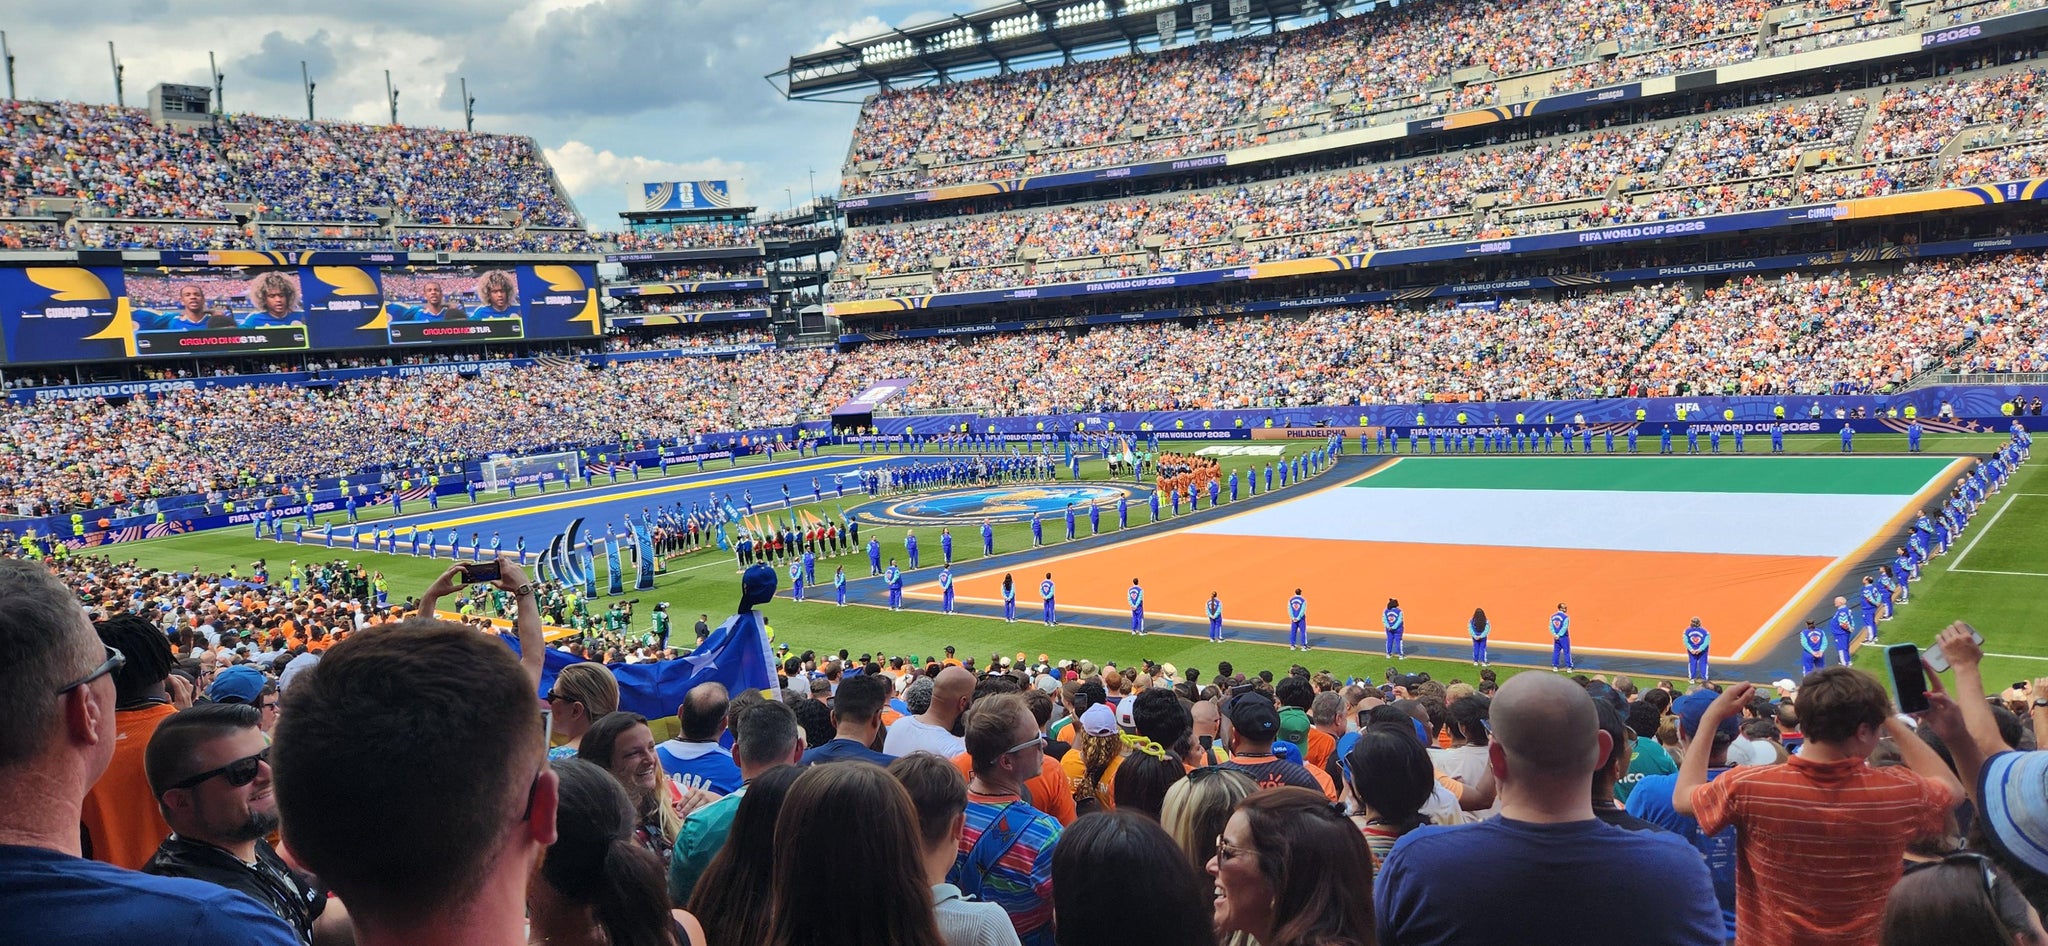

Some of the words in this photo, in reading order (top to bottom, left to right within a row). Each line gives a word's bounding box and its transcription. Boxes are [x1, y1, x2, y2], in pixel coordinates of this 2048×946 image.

[1159, 20, 1174, 29] 1947
[1937, 25, 1981, 42] 2026
[1172, 161, 1190, 170] FIFA
[1190, 158, 1218, 168] WORLD
[846, 199, 868, 208] 2026
[1579, 231, 1601, 243] FIFA
[1602, 227, 1641, 241] WORLD
[1643, 225, 1665, 236] CUP
[1665, 221, 1706, 234] 2026
[1658, 261, 1756, 275] PHILADELPHIA
[1086, 283, 1103, 291] FIFA
[1103, 280, 1131, 290] WORLD
[1131, 279, 1147, 288] CUP
[1147, 276, 1175, 286] 2026
[1467, 283, 1491, 291] WORLD
[1491, 282, 1505, 290] CUP
[1505, 280, 1530, 288] 2026
[1279, 296, 1346, 307] PHILADELPHIA
[938, 324, 996, 334] PHILADELPHIA
[682, 345, 762, 355] PHILADELPHIA
[400, 366, 421, 376] FIFA
[422, 364, 458, 375] WORLD
[459, 363, 479, 373] CUP
[480, 361, 511, 372] 2026
[36, 388, 67, 401] FIFA
[68, 385, 120, 398] WORLD
[121, 383, 148, 394] CUP
[149, 381, 195, 393] 2026
[1675, 402, 1700, 412] FIFA
[1087, 417, 1101, 425] FIFA
[1460, 427, 1478, 435] CUP
[1780, 422, 1821, 431] 2026
[1193, 431, 1207, 439] CUP
[1287, 429, 1347, 438] PHILADELPHIA
[709, 450, 730, 458] 2026
[514, 476, 529, 484] CUP
[228, 514, 250, 524] FIFA
[250, 509, 284, 520] WOLD
[284, 506, 303, 516] CUP
